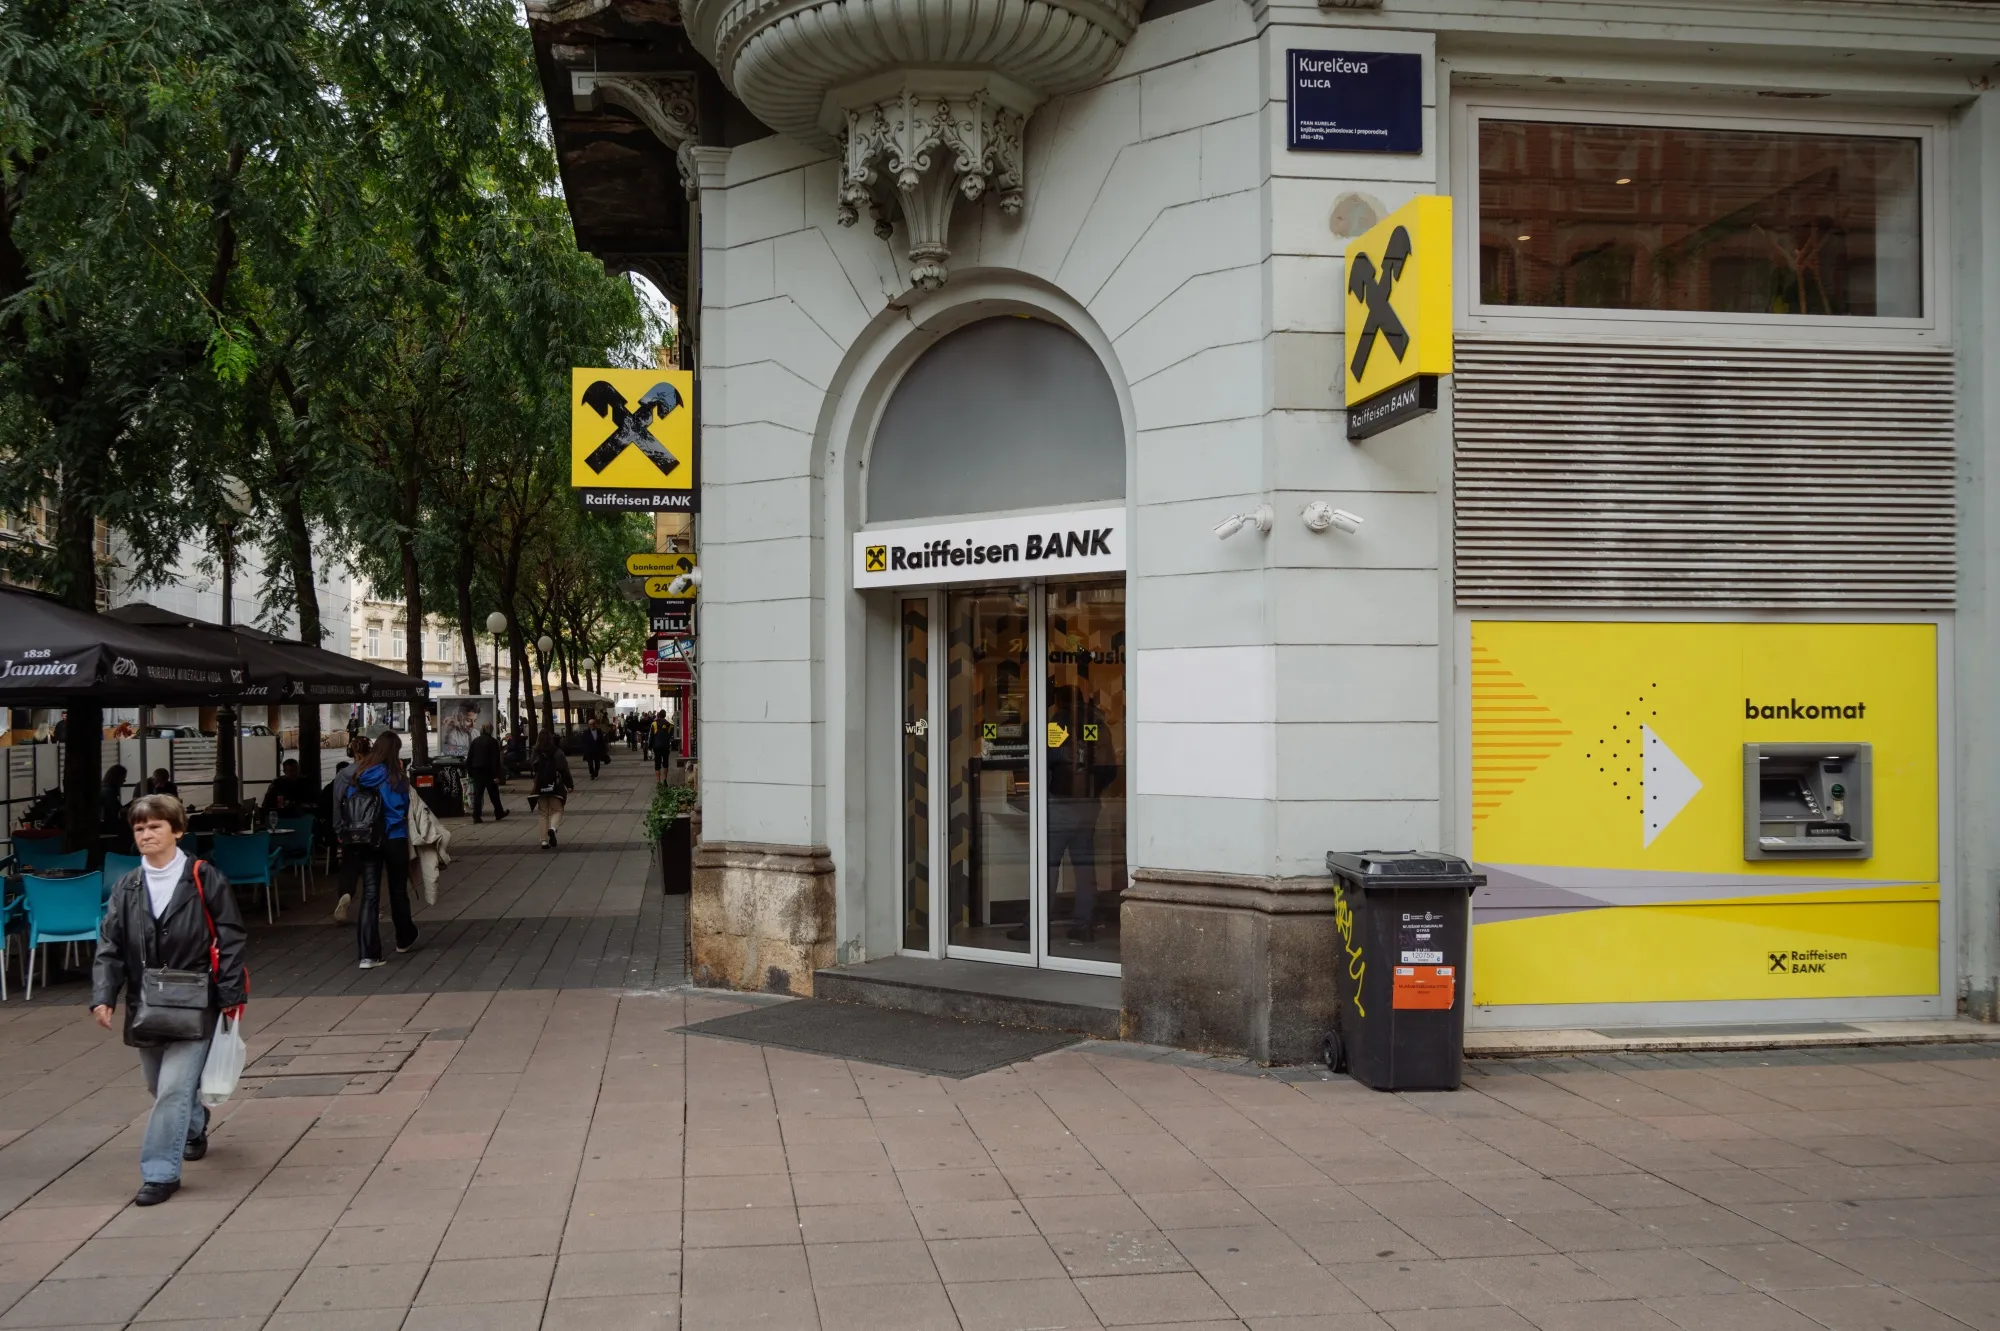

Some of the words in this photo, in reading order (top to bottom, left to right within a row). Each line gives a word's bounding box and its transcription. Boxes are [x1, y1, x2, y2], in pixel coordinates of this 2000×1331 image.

[1300, 57, 1368, 73] Kurelčeva
[1300, 79, 1331, 88] ULICA
[1352, 403, 1390, 428] Raiffeisen
[1390, 387, 1416, 412] BANK
[586, 494, 649, 505] Raiffeisen
[652, 495, 691, 506] BANK
[891, 538, 1019, 570] Raiffeisen
[1025, 528, 1114, 560] BANK
[654, 620, 686, 629] HILL
[23, 649, 51, 658] 1828
[0, 660, 78, 679] Jamnica
[147, 666, 176, 680] PRIRODNA
[177, 668, 206, 682] MINERALNA
[207, 671, 222, 683] VODA
[1745, 698, 1866, 719] bankomat
[1791, 949, 1848, 960] Raiffeisen
[1792, 963, 1826, 973] BANK
